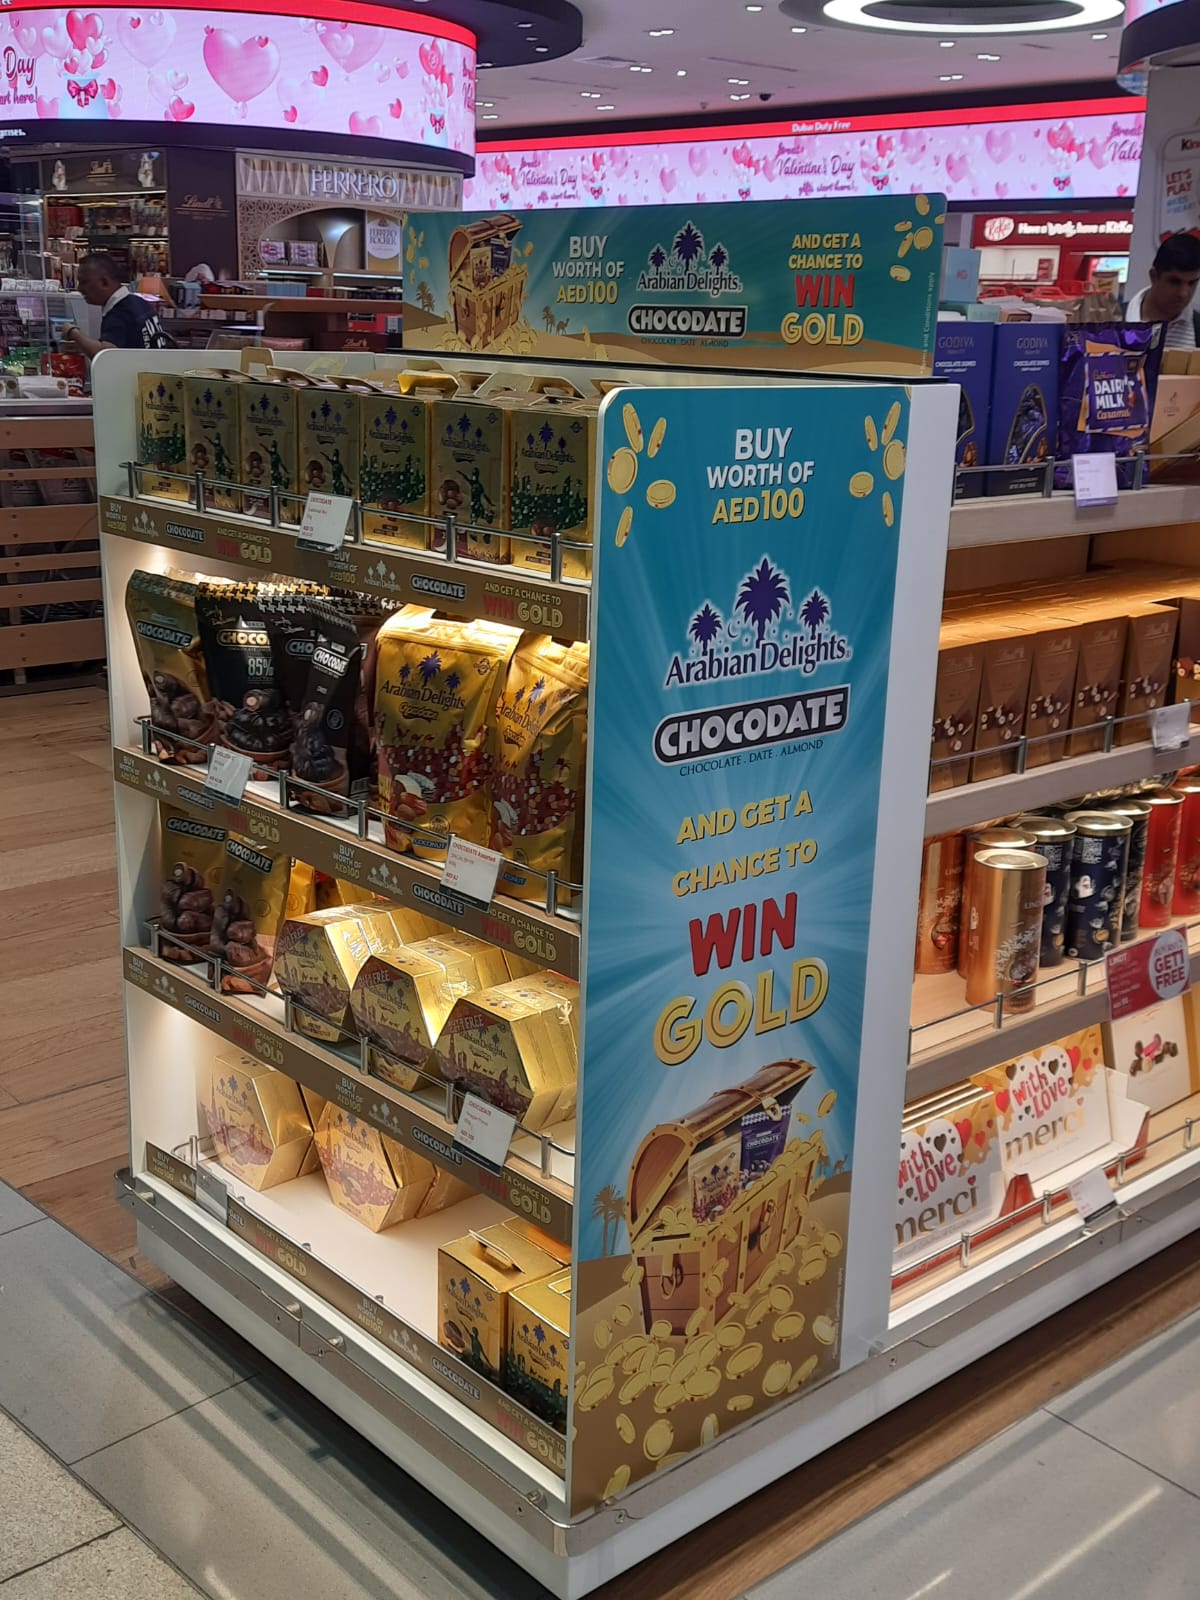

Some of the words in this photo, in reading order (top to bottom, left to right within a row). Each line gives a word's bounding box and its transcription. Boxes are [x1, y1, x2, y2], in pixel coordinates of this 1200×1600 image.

[4, 46, 35, 86] Day
[815, 122, 832, 132] Duty
[833, 120, 851, 130] Free
[560, 167, 578, 190] Day
[830, 154, 855, 179] Day
[311, 169, 397, 198] FERRERO
[1105, 220, 1133, 234] KitKa
[569, 235, 608, 259] BUY
[792, 234, 821, 249] AND
[822, 233, 849, 249] GET
[849, 233, 862, 248] A
[552, 261, 602, 278] WORTH
[605, 261, 624, 278] OF
[788, 254, 842, 270] CHANCE
[844, 253, 864, 269] TO
[638, 271, 685, 291] Arabian
[686, 272, 741, 297] Delights
[794, 273, 855, 308] WIN
[630, 309, 744, 333] CHOCODATE
[780, 312, 864, 346] GOLD
[938, 336, 974, 349] GODIVA
[1016, 337, 1048, 349] GODIVA
[1096, 393, 1125, 410] MILK
[734, 427, 793, 461] BUY
[706, 461, 782, 489] WORTH
[788, 461, 815, 484] OF
[110, 502, 122, 513] BUY
[166, 523, 204, 541] CHOCODATE
[240, 542, 272, 564] GOLD
[412, 576, 465, 599] CHOCODATE
[485, 582, 500, 593] AND
[500, 585, 514, 596] GET
[514, 588, 520, 597] A
[521, 590, 550, 604] CHANCE
[551, 596, 561, 606] TO
[517, 601, 563, 628] GOLD
[136, 622, 191, 647] CHOCODATE
[220, 632, 270, 646] CHOCO
[248, 658, 274, 677] 85%
[665, 646, 756, 686] Arabian
[760, 633, 847, 674] Delights
[381, 679, 421, 702] Arabian
[421, 687, 465, 712] Delights
[659, 692, 845, 758] CHOCODATE
[123, 755, 135, 767] BUY
[679, 755, 742, 777] CHOCOLATE
[749, 751, 773, 764] DATE
[781, 738, 824, 758] ALMOND
[167, 818, 225, 841] CHOCODATE
[675, 807, 737, 845] AND
[740, 793, 791, 830] GET
[794, 789, 814, 817] A
[249, 819, 280, 843] GOLD
[226, 839, 272, 872] CHOCODATE
[339, 844, 355, 858] BUY
[671, 847, 781, 897] CHANCE
[784, 838, 819, 868] TO
[412, 884, 464, 915] CHOCODATE
[497, 911, 510, 922] GET
[511, 917, 516, 925] A
[517, 920, 545, 937] CHANCE
[545, 930, 555, 941] TO
[688, 891, 798, 977] WIN
[513, 930, 557, 962] GOLD
[1155, 966, 1186, 990] FREE
[653, 956, 830, 1066] GOLD
[254, 1037, 285, 1065] GOLD
[341, 1077, 358, 1092] BUY
[413, 1128, 462, 1163] CHOCODATE
[1006, 1105, 1086, 1161] merci
[513, 1179, 540, 1199] CHANCE
[541, 1193, 550, 1205] TO
[510, 1188, 552, 1224] GOLD
[277, 1247, 307, 1277] GOLD
[432, 1358, 480, 1400] CHOCODATE
[526, 1431, 567, 1470] GOLD
